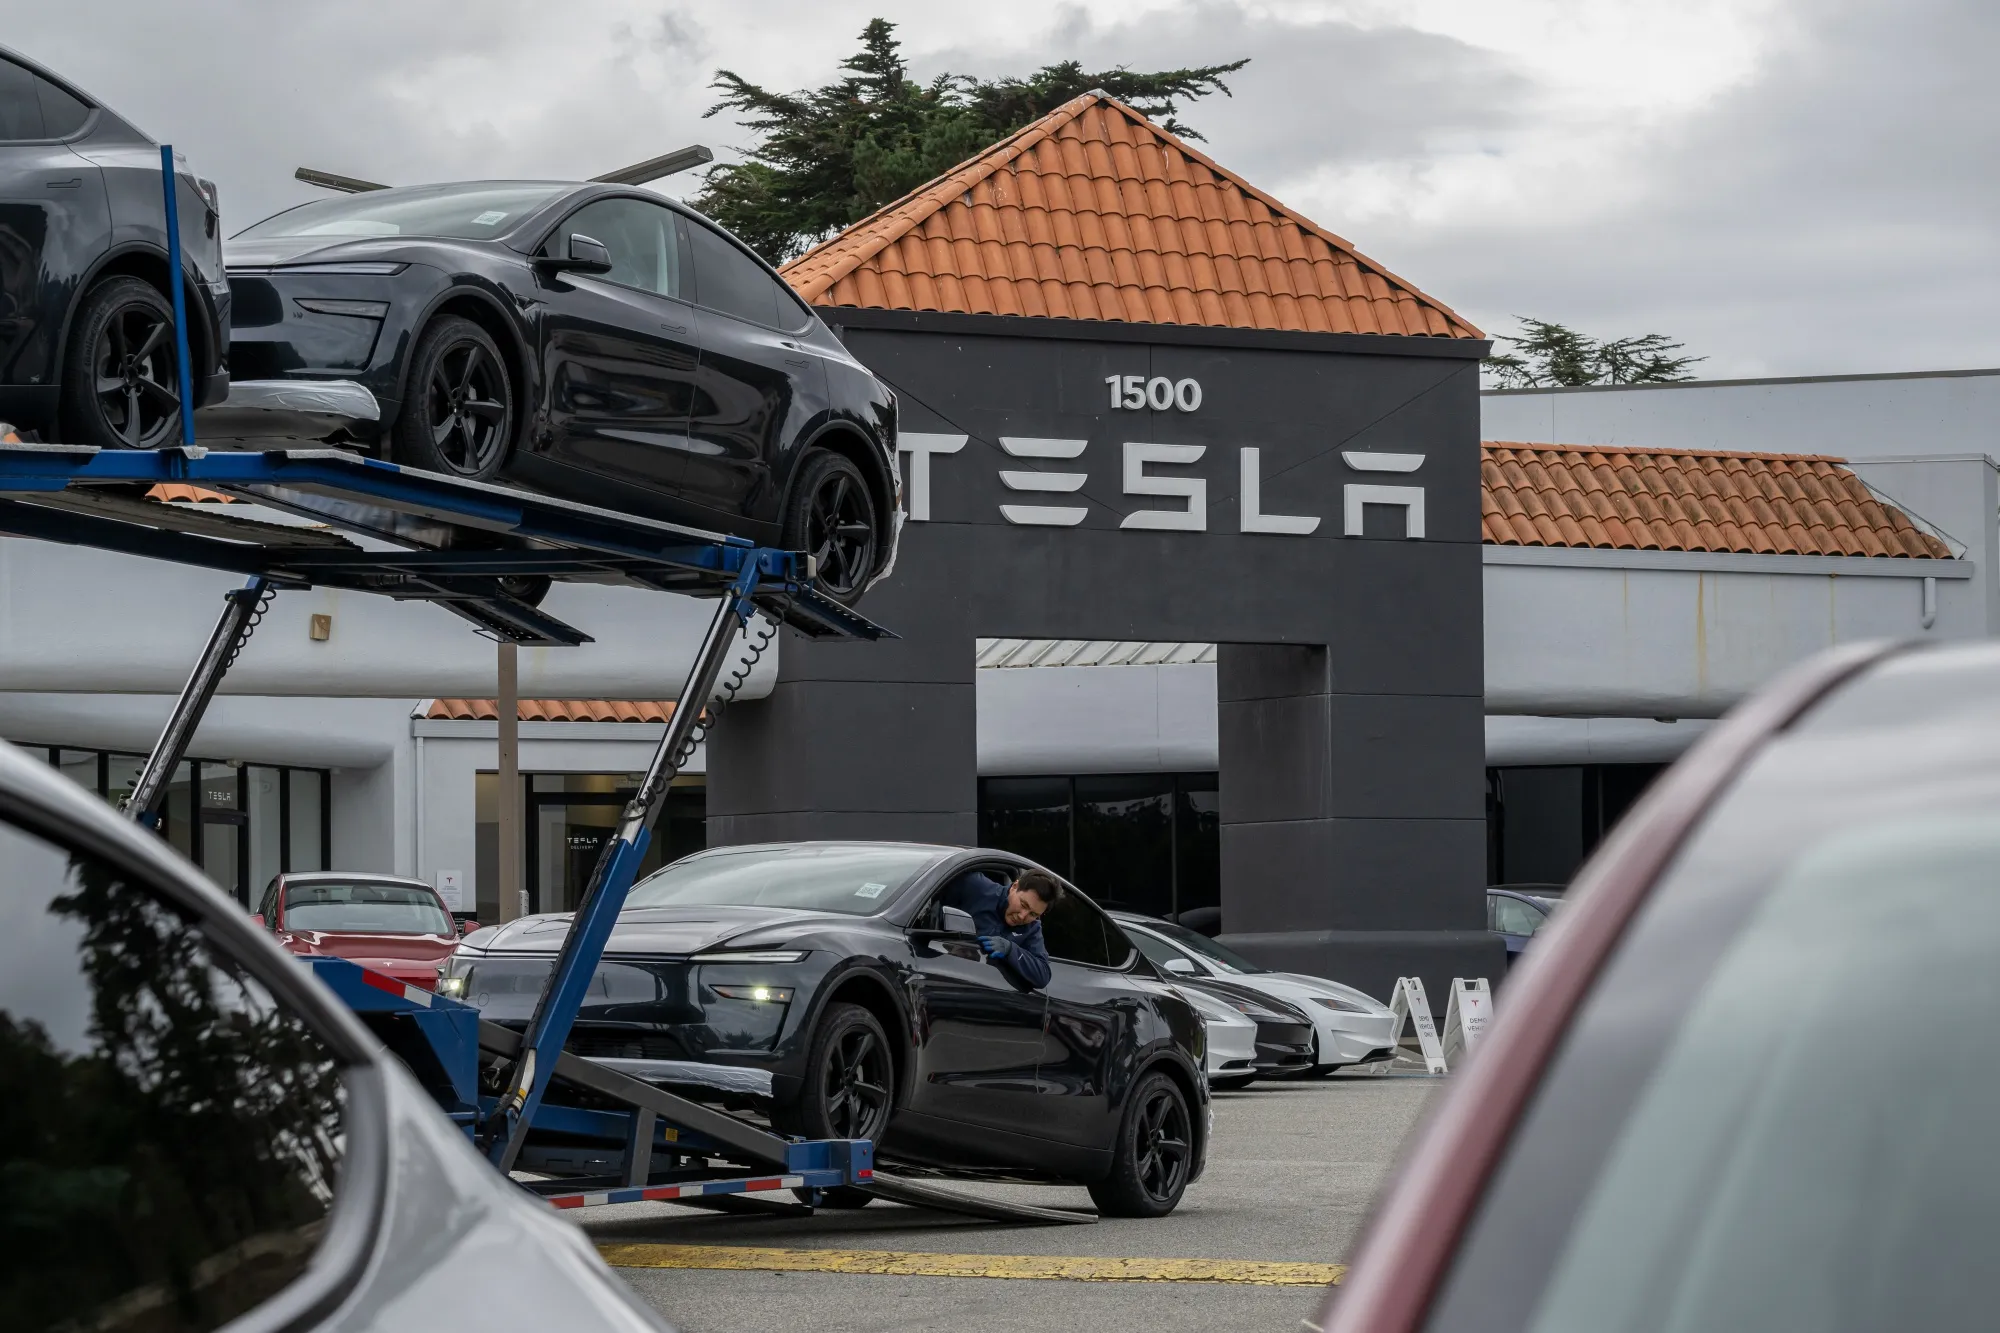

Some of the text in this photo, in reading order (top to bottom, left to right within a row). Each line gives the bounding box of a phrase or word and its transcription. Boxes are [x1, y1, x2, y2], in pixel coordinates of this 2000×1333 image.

[1105, 374, 1203, 413] 1500
[898, 432, 1426, 540] TESLA
[208, 790, 231, 801] TESLA
